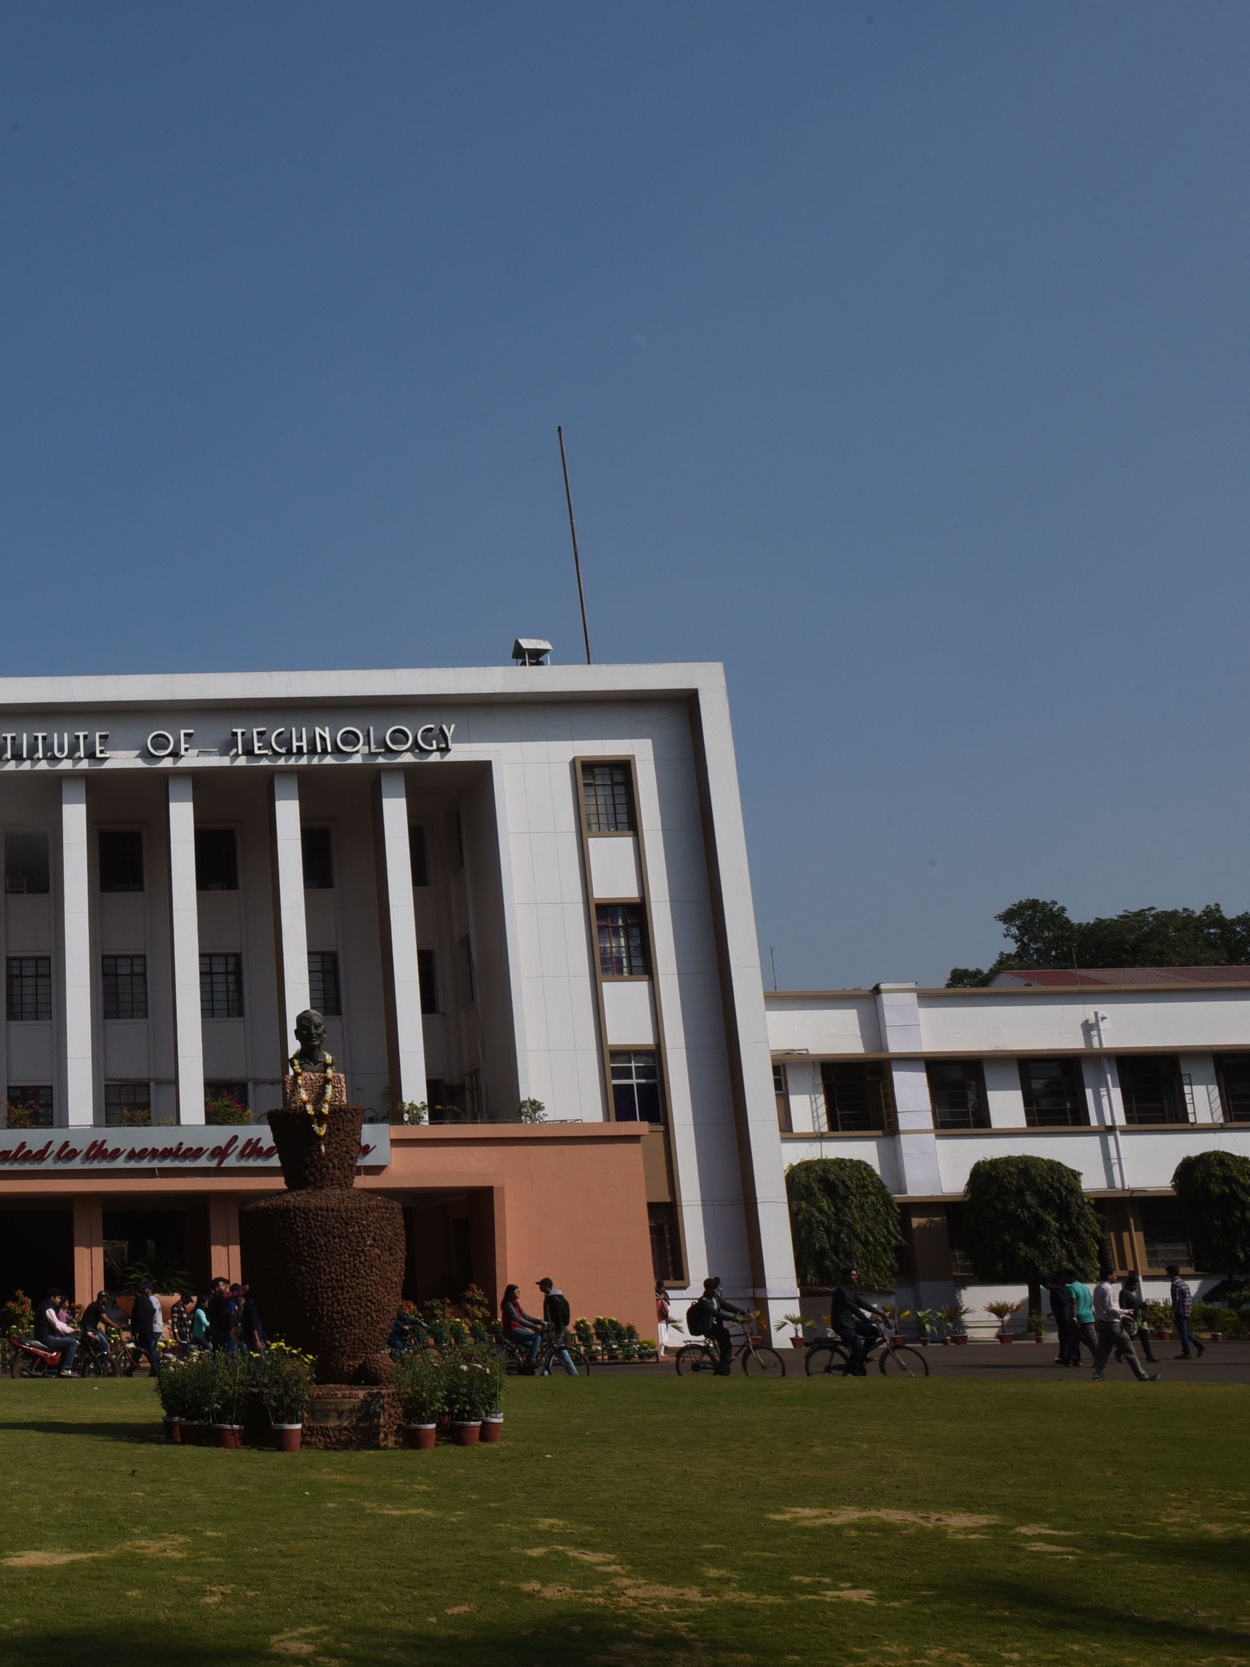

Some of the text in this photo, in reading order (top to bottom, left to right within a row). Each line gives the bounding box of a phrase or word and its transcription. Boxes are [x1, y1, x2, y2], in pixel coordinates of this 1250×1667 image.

[147, 729, 194, 757] OF
[232, 724, 455, 755] TECHNOLOGY
[56, 1139, 84, 1160] to
[86, 1138, 126, 1160] the
[129, 1142, 210, 1160] service
[212, 1134, 240, 1166] of
[240, 1137, 278, 1159] the
